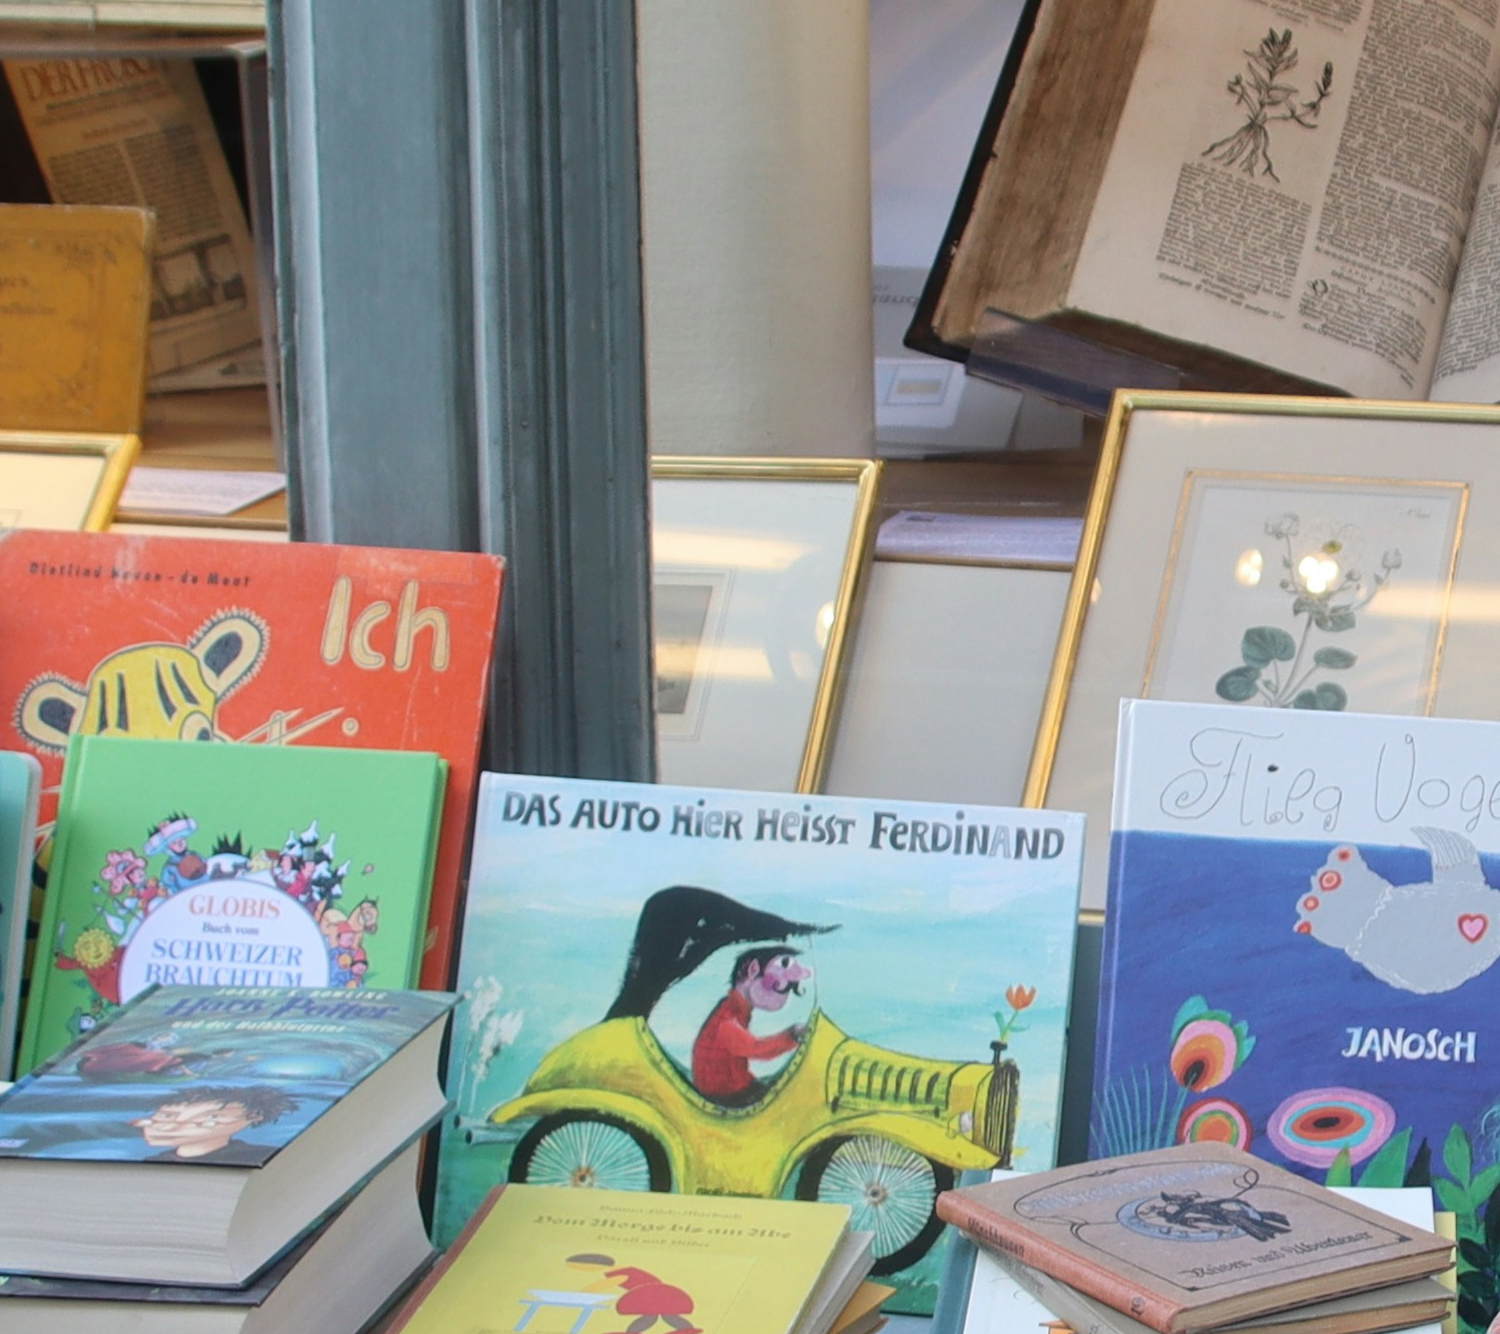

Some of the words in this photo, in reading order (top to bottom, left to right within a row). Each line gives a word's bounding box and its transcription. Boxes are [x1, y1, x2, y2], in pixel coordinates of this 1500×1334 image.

[320, 574, 450, 673] Ich
[1159, 726, 1343, 832] Flieg
[501, 790, 562, 829] DAS
[568, 797, 660, 834] AUTO
[188, 893, 281, 919] GLOBIS
[202, 921, 230, 935] Buch
[235, 925, 260, 936] vom
[150, 937, 303, 966] SCHWEIZER
[145, 963, 303, 988] BRAUCHTUM
[164, 996, 266, 1018] Harry
[269, 996, 402, 1019] Potter
[1341, 1026, 1477, 1064] JANOSCH
